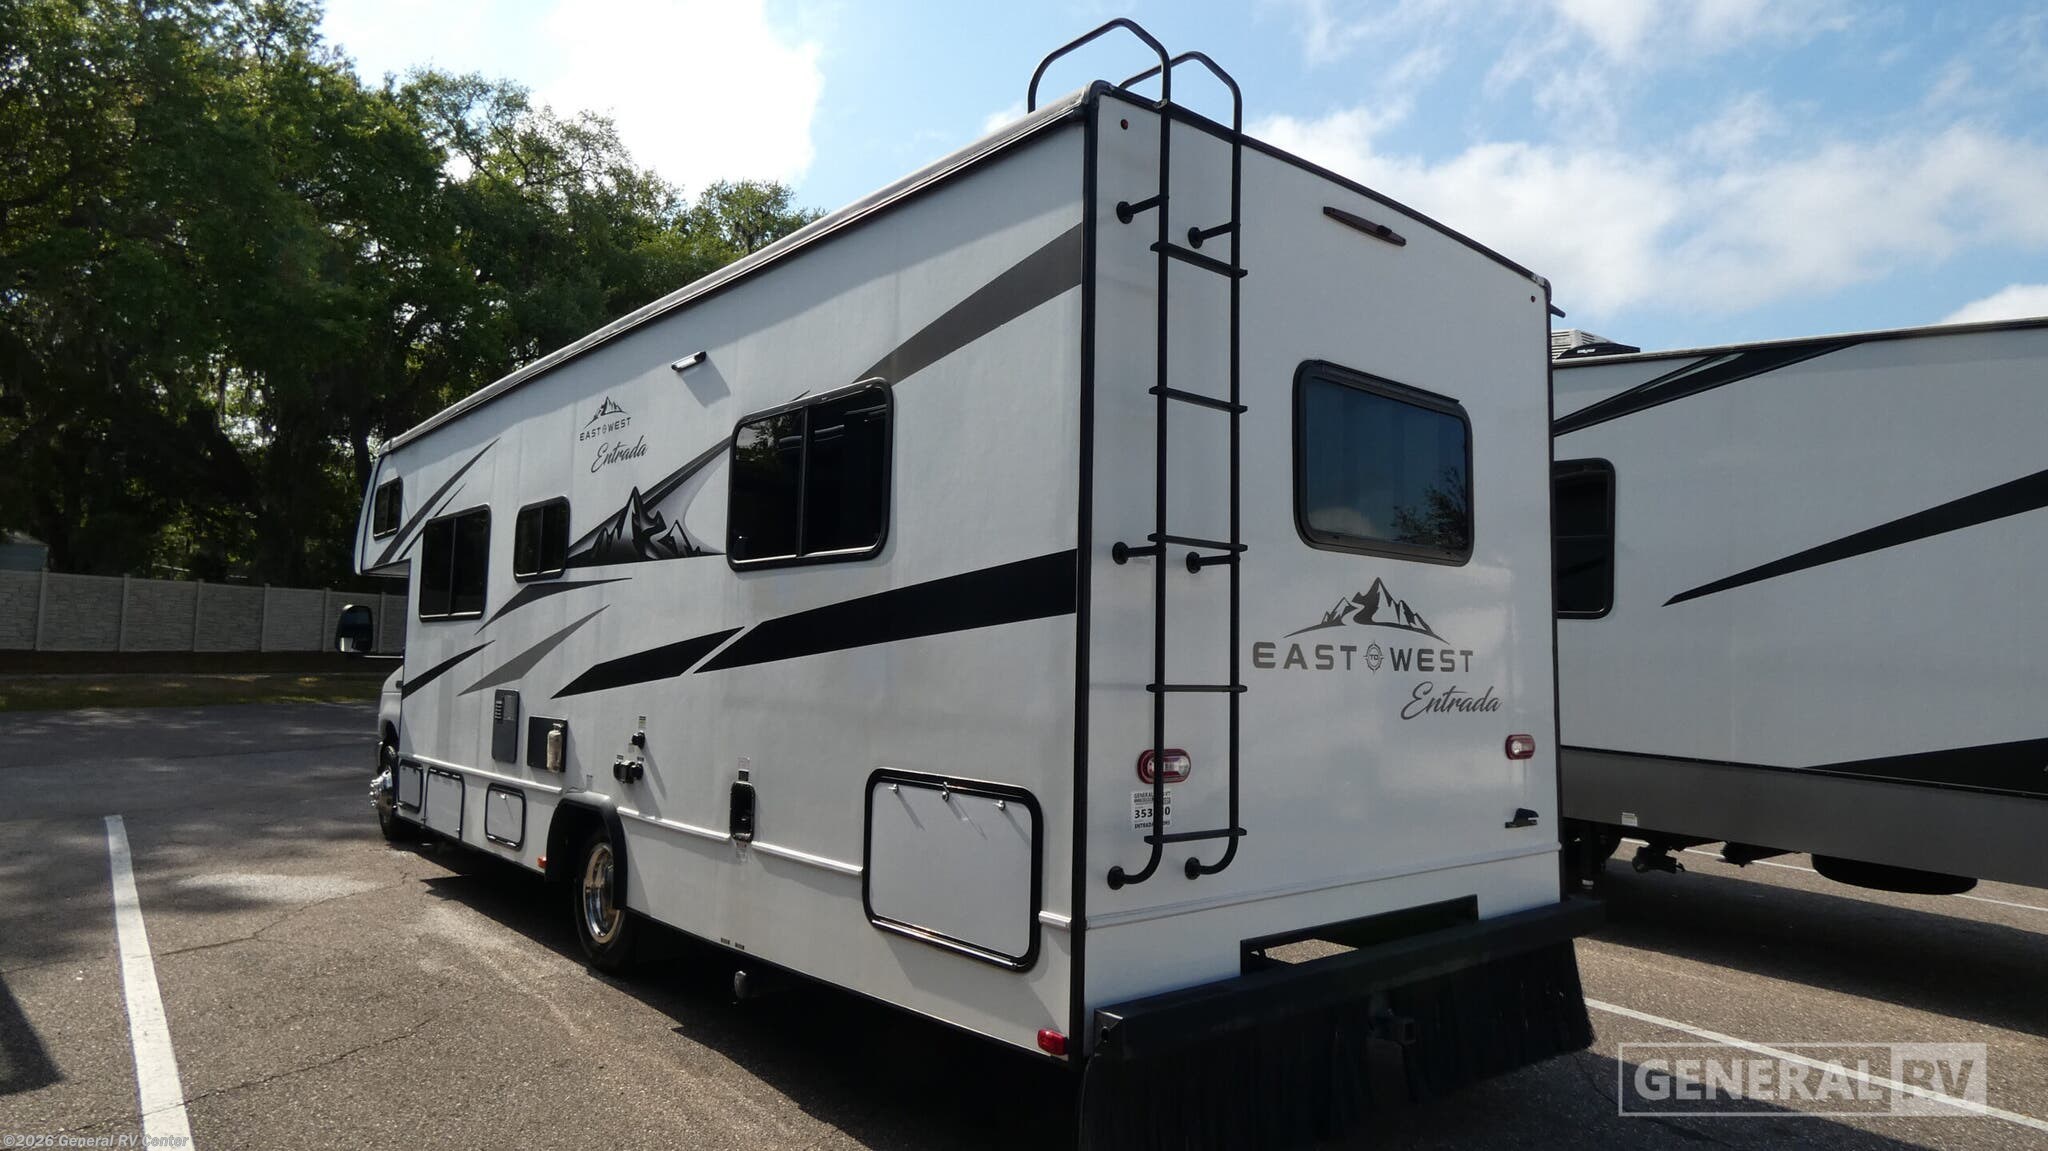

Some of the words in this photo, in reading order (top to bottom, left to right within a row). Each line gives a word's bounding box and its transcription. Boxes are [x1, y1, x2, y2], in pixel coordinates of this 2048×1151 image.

[579, 428, 601, 442] EAST
[608, 417, 632, 432] WEST
[591, 435, 648, 473] Entrada
[1252, 641, 1358, 671] EAST
[1389, 647, 1474, 673] WEST
[1401, 681, 1502, 720] Entrada
